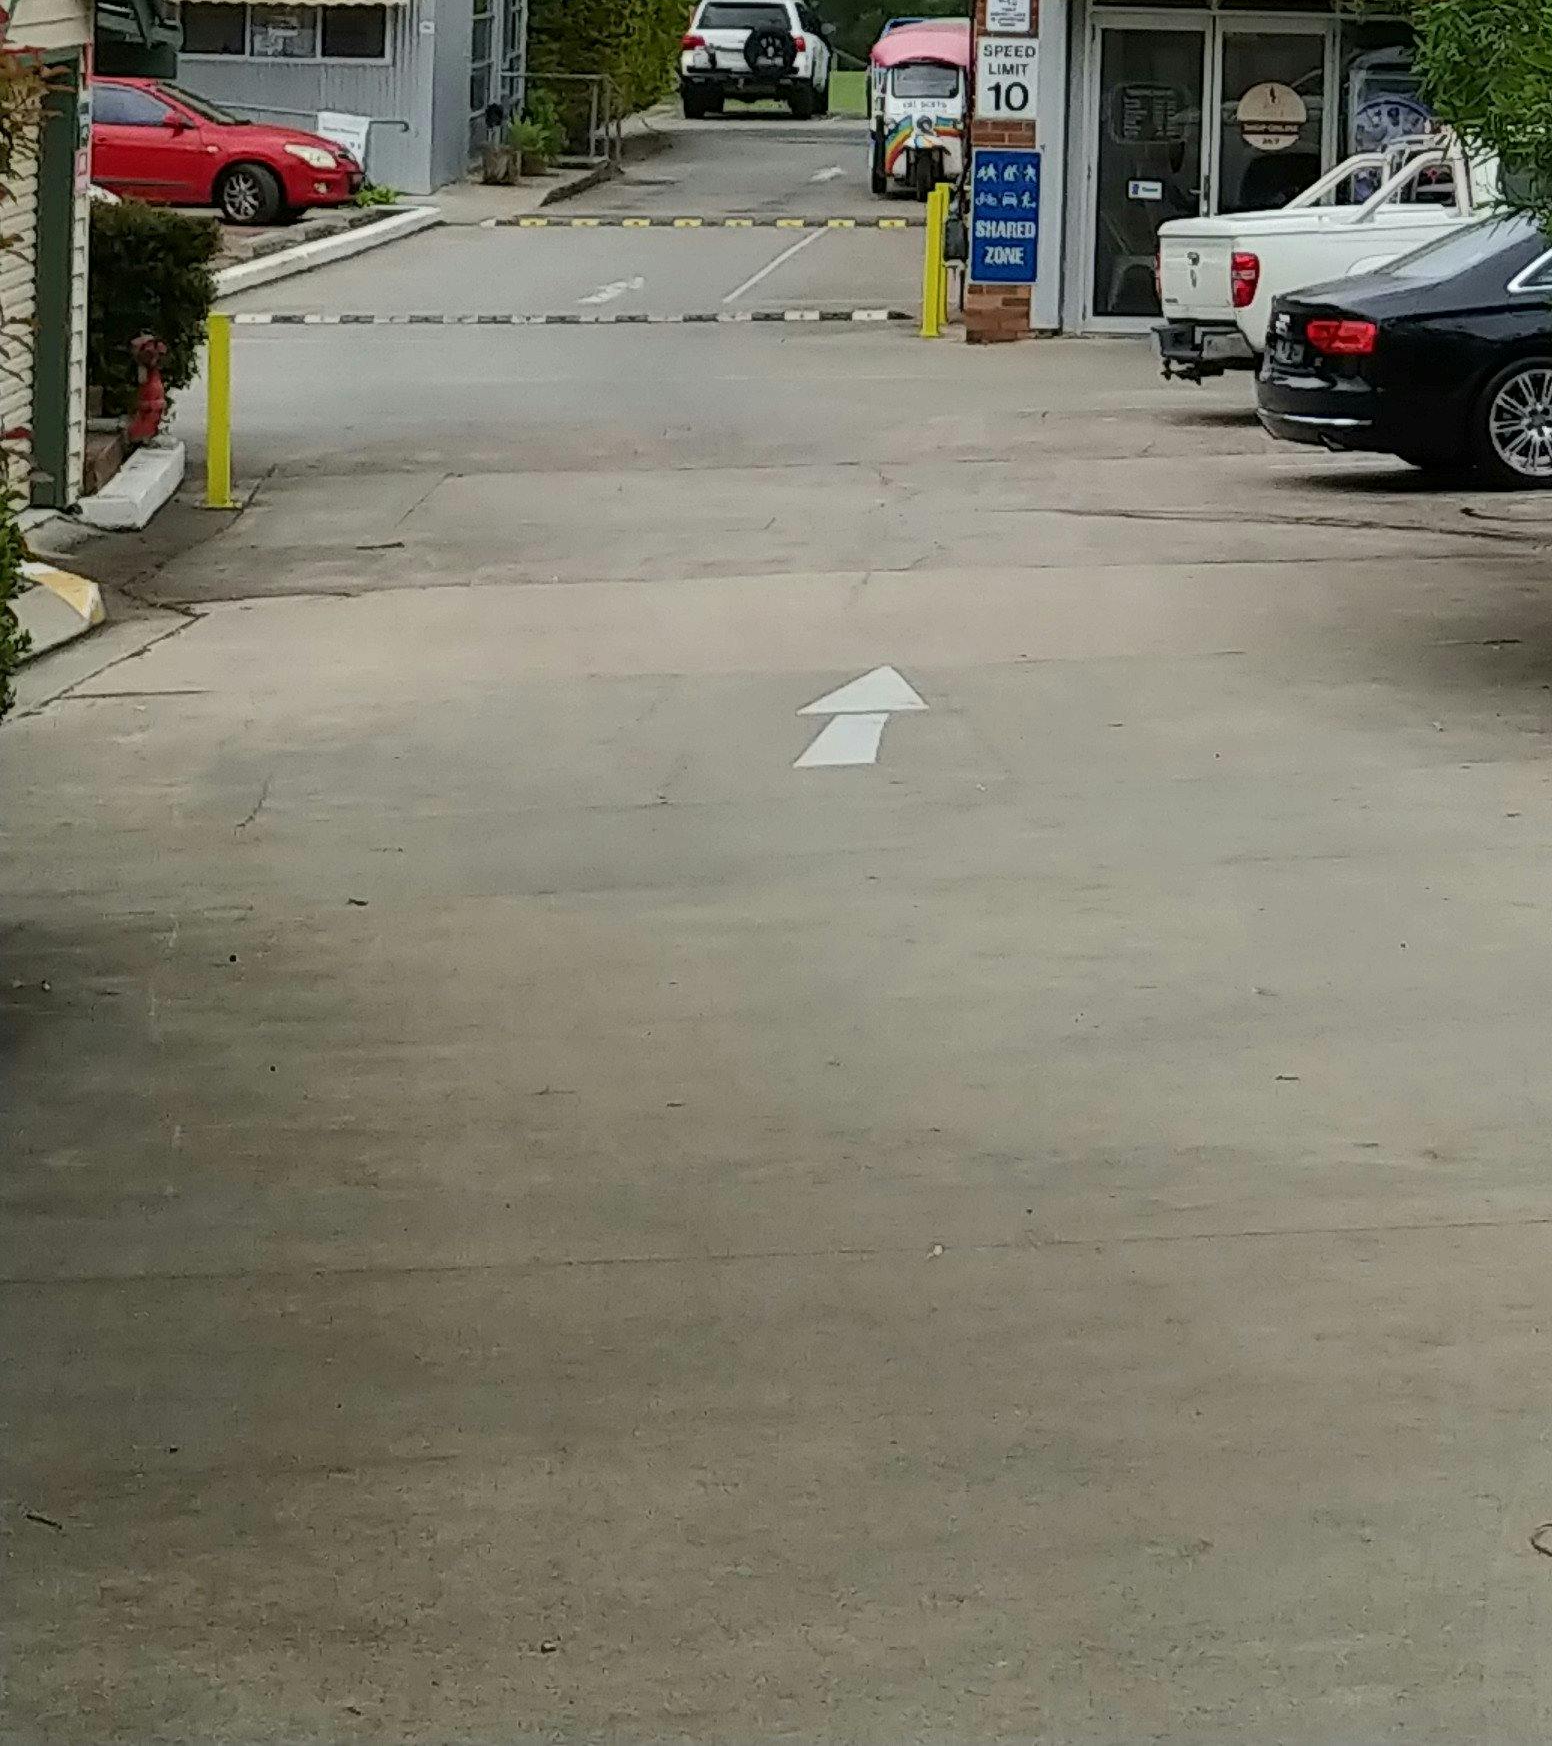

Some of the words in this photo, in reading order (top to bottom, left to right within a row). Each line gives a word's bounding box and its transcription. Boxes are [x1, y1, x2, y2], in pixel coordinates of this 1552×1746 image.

[983, 44, 1037, 59] SPEED
[988, 62, 1030, 77] LIMIT
[987, 81, 1029, 112] 10
[975, 219, 1036, 239] SHARED
[984, 245, 1024, 266] ZONE
